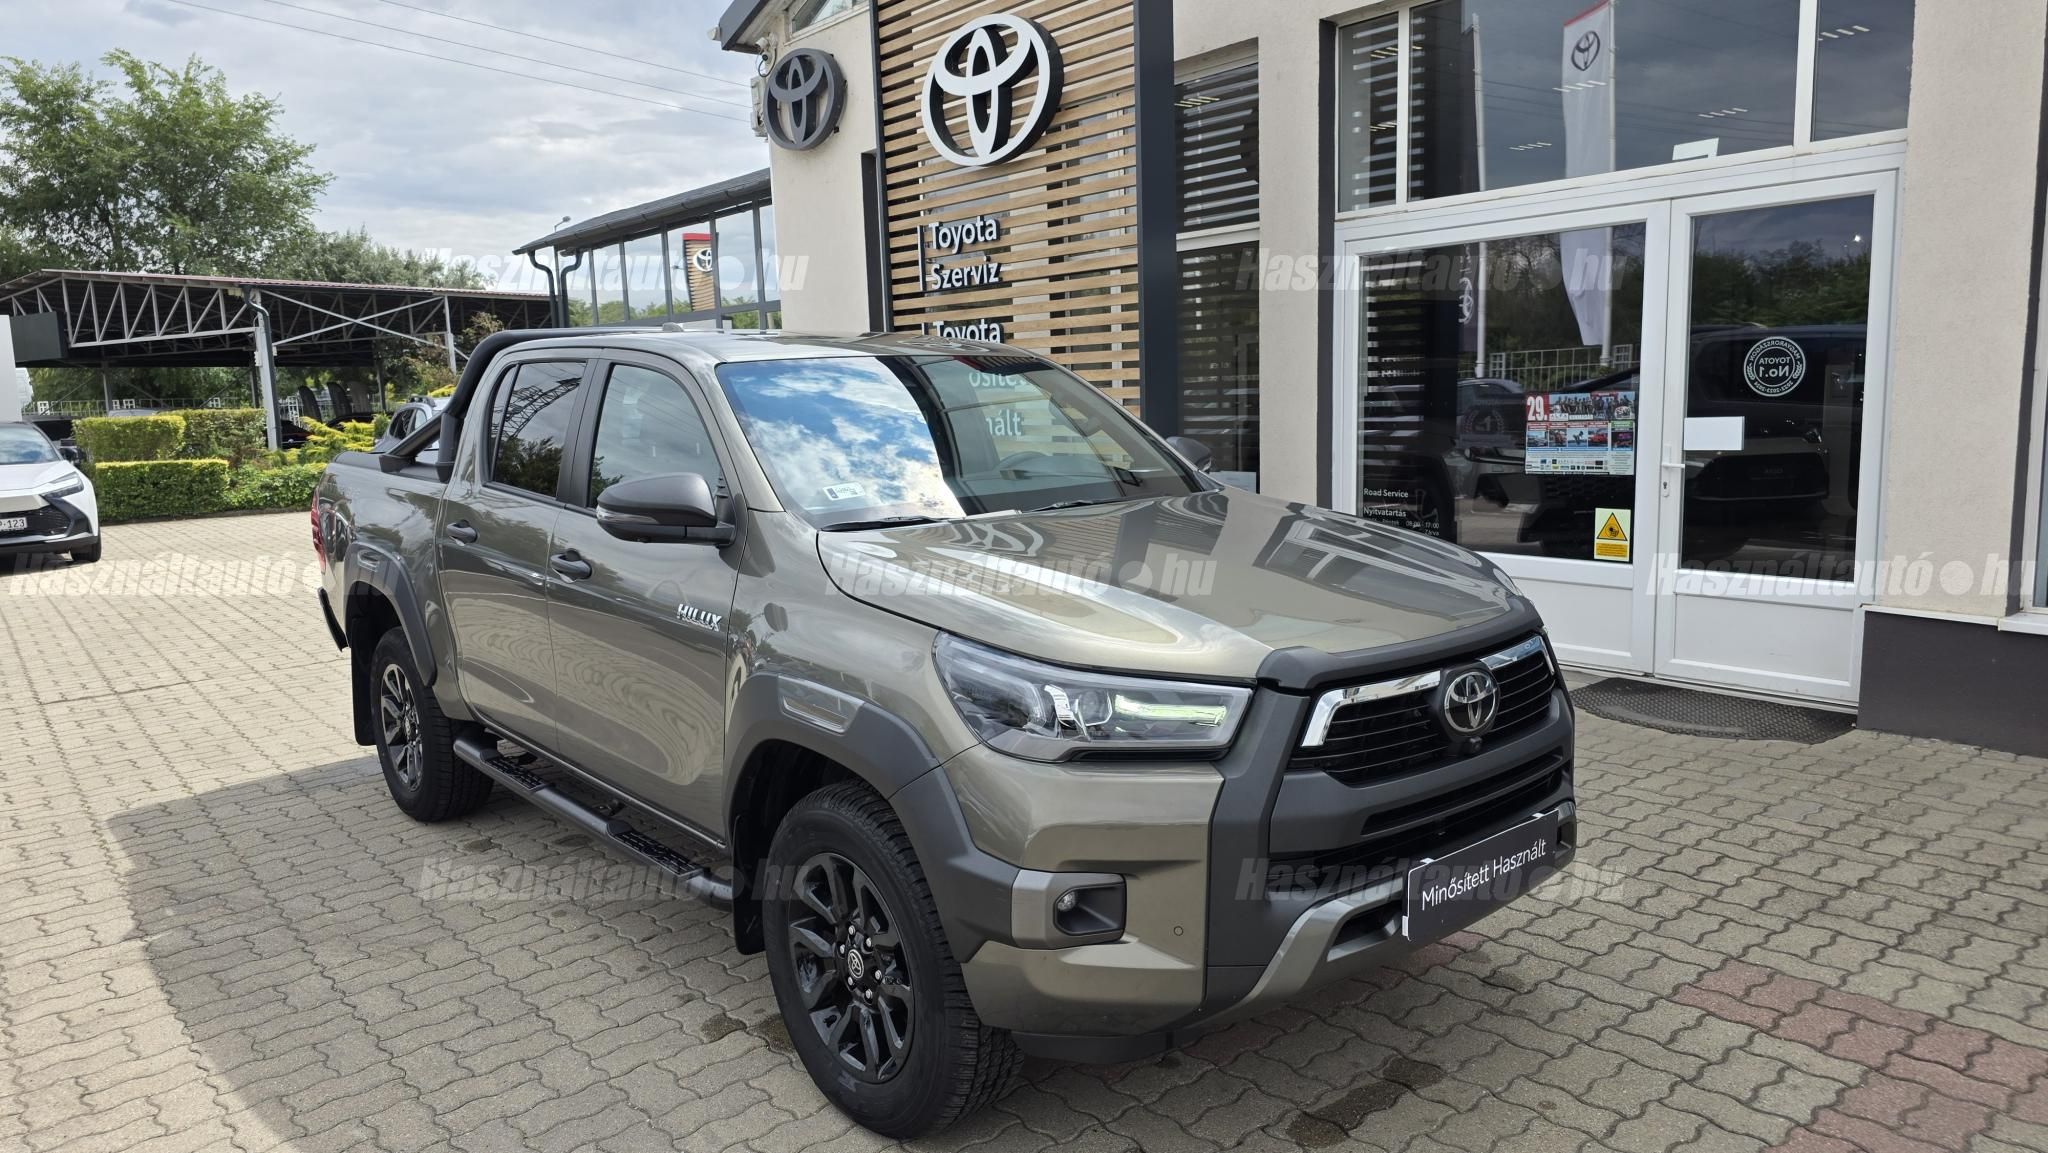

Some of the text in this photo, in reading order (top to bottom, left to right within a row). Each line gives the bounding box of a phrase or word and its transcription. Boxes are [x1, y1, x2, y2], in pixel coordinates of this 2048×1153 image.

[929, 216, 998, 253] Toyota
[931, 256, 1000, 289] Szerviz
[1526, 395, 1548, 421] 29.
[1363, 487, 1409, 498] Road Service
[1363, 506, 1407, 518] Nyitvatartás
[677, 603, 723, 632] HILUX
